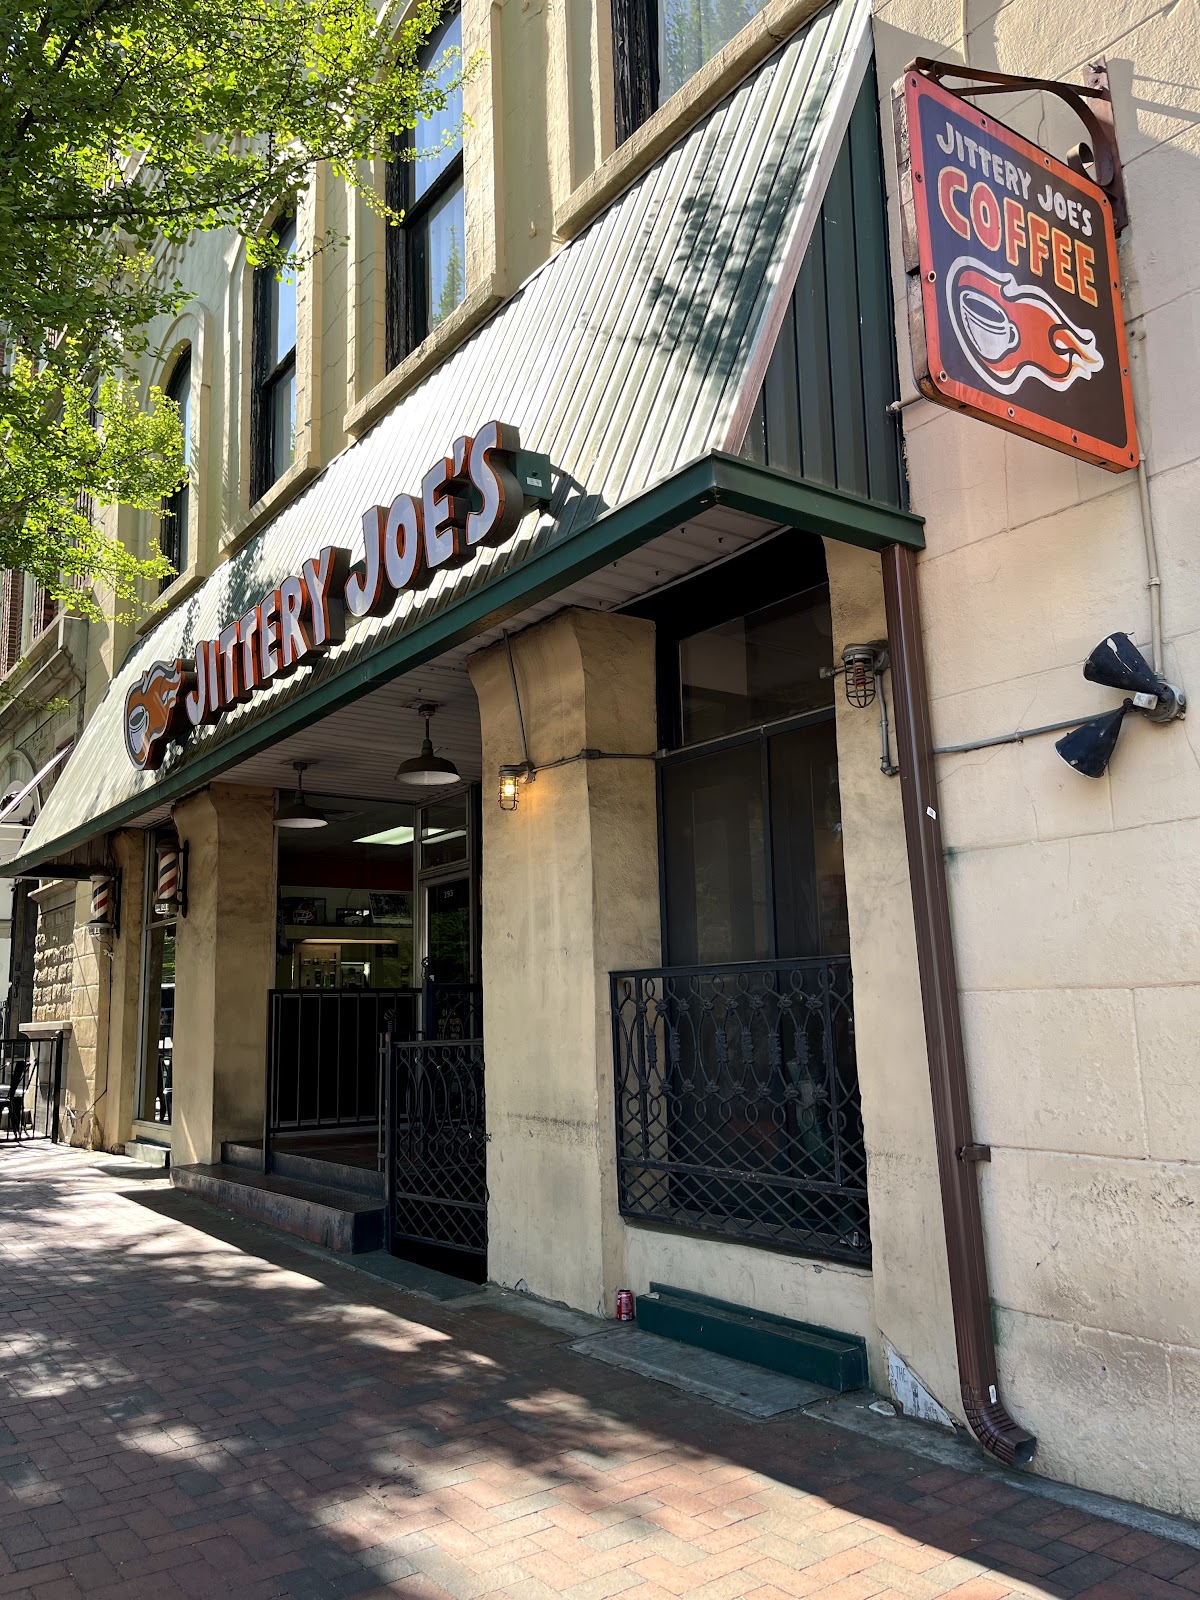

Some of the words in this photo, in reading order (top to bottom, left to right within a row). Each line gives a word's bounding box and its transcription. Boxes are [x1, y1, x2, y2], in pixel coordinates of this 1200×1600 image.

[936, 122, 1032, 201] JITTERY
[1037, 184, 1093, 237] JOE'S
[938, 165, 1099, 308] COFFEE
[186, 546, 338, 725] JITTERY
[344, 420, 504, 616] JOE'S
